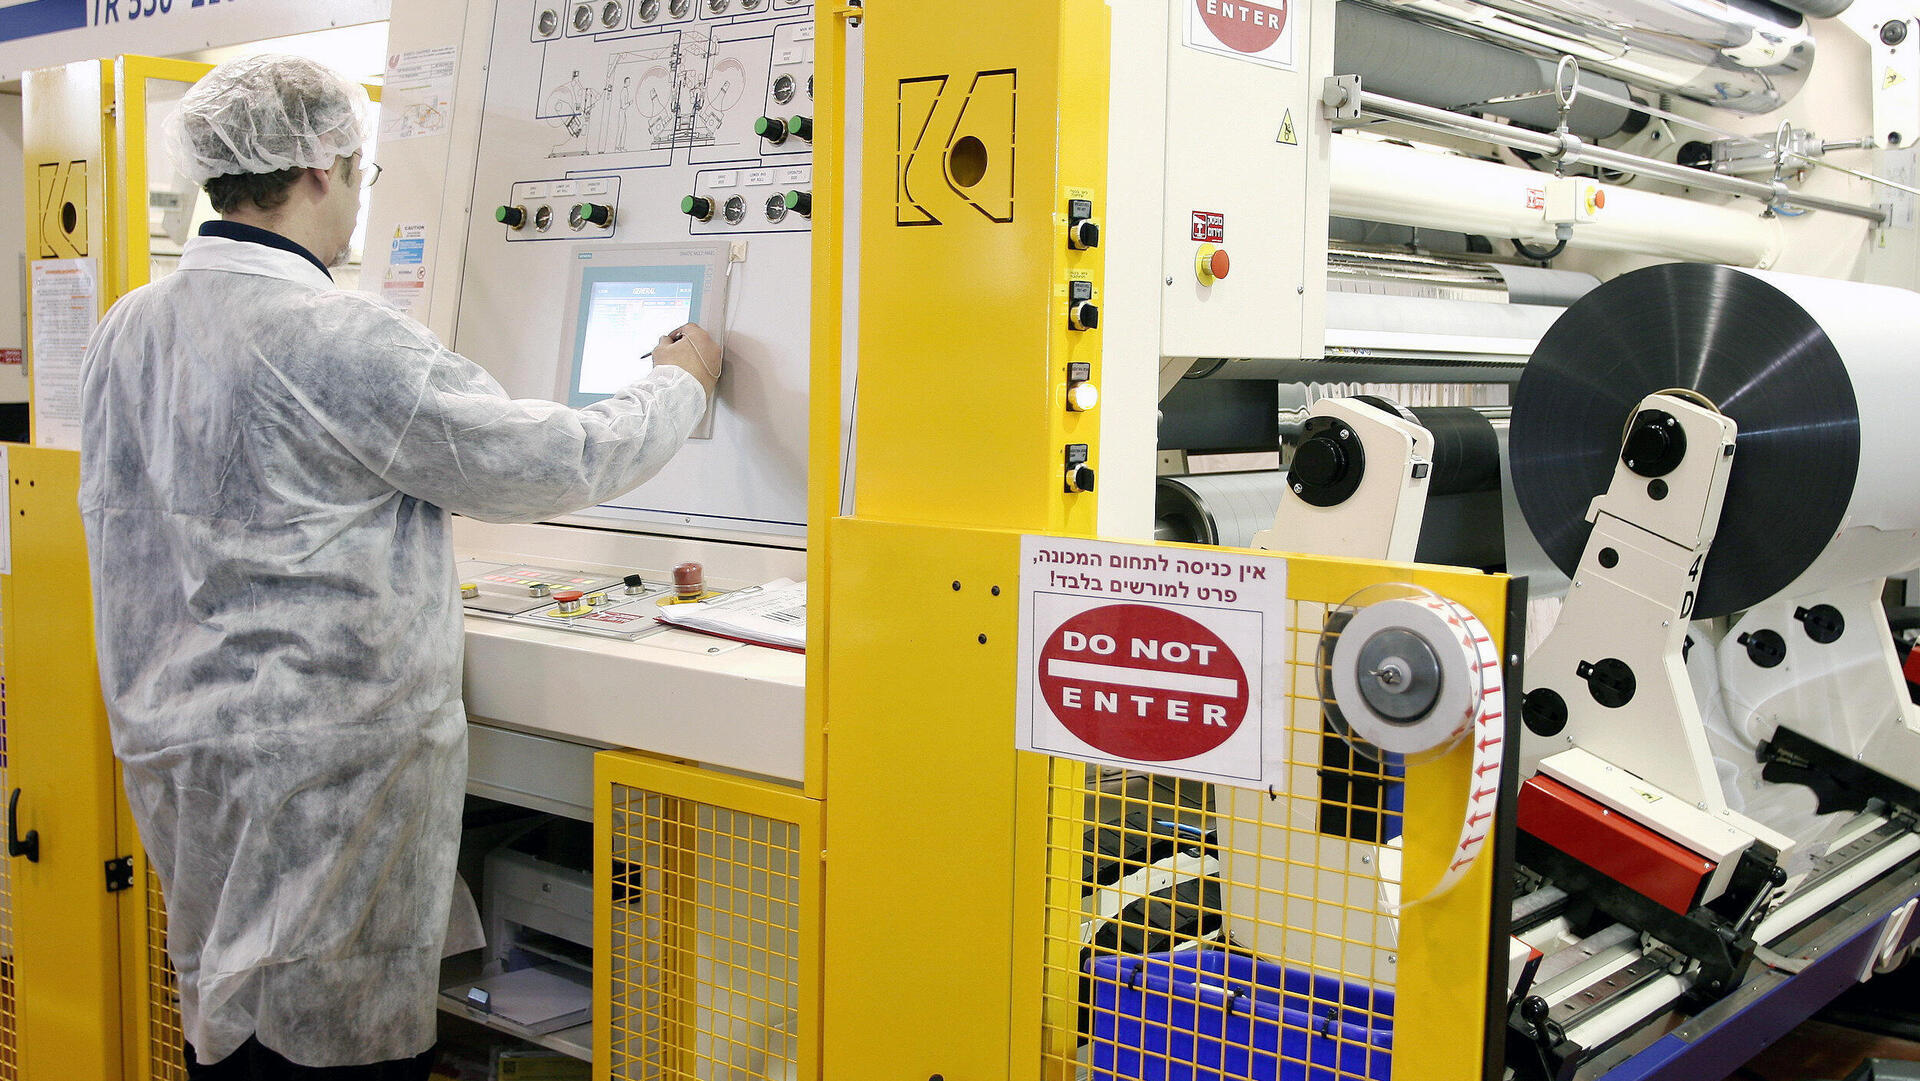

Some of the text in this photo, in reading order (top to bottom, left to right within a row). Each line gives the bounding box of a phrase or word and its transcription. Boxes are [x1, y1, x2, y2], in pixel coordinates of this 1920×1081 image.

[1206, 0, 1280, 30] ENTER
[1032, 549, 1267, 582] אין כניסה לתחום המכונה,
[1688, 553, 1703, 582] 4
[1049, 570, 1237, 603] פרט למורשים בלבד!
[1680, 590, 1695, 619] D
[1063, 630, 1217, 666] DO NOT
[1062, 686, 1228, 727] ENTER
